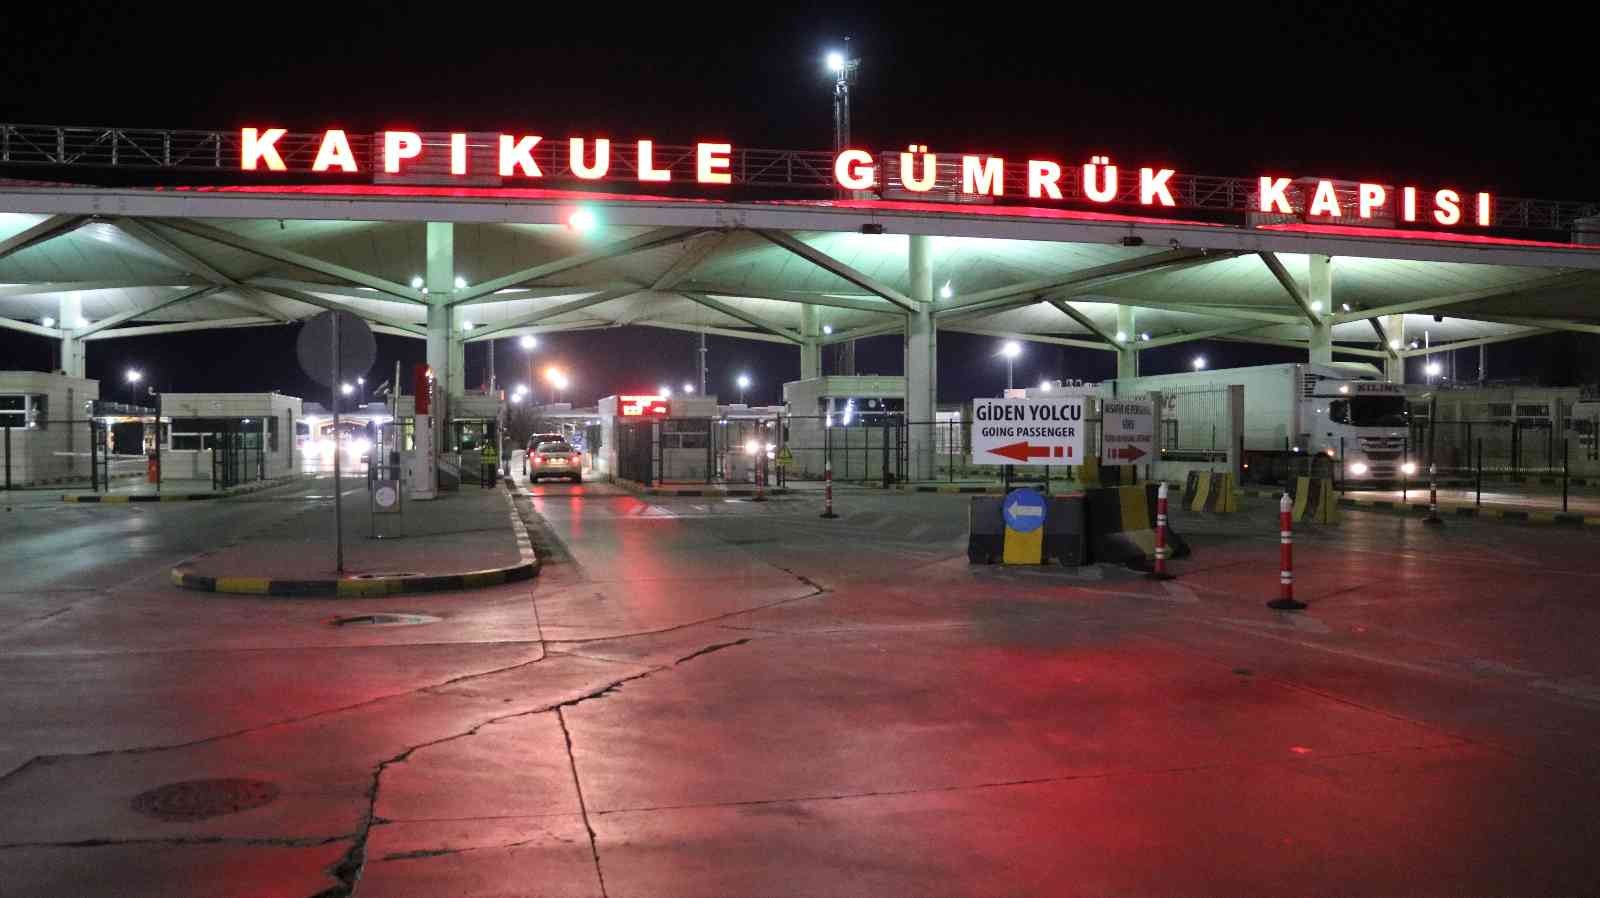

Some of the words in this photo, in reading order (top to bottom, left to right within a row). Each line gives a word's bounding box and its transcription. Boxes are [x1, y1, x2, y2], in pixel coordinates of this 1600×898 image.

[241, 127, 732, 184] KAPIKULE
[834, 144, 1176, 207] GÜMRÜK
[1259, 176, 1490, 226] KAPISI
[976, 401, 1025, 421] GİDEN
[1029, 404, 1081, 421] YOLCU
[982, 426, 1014, 437] GOING
[1016, 427, 1075, 437] PASSENGER
